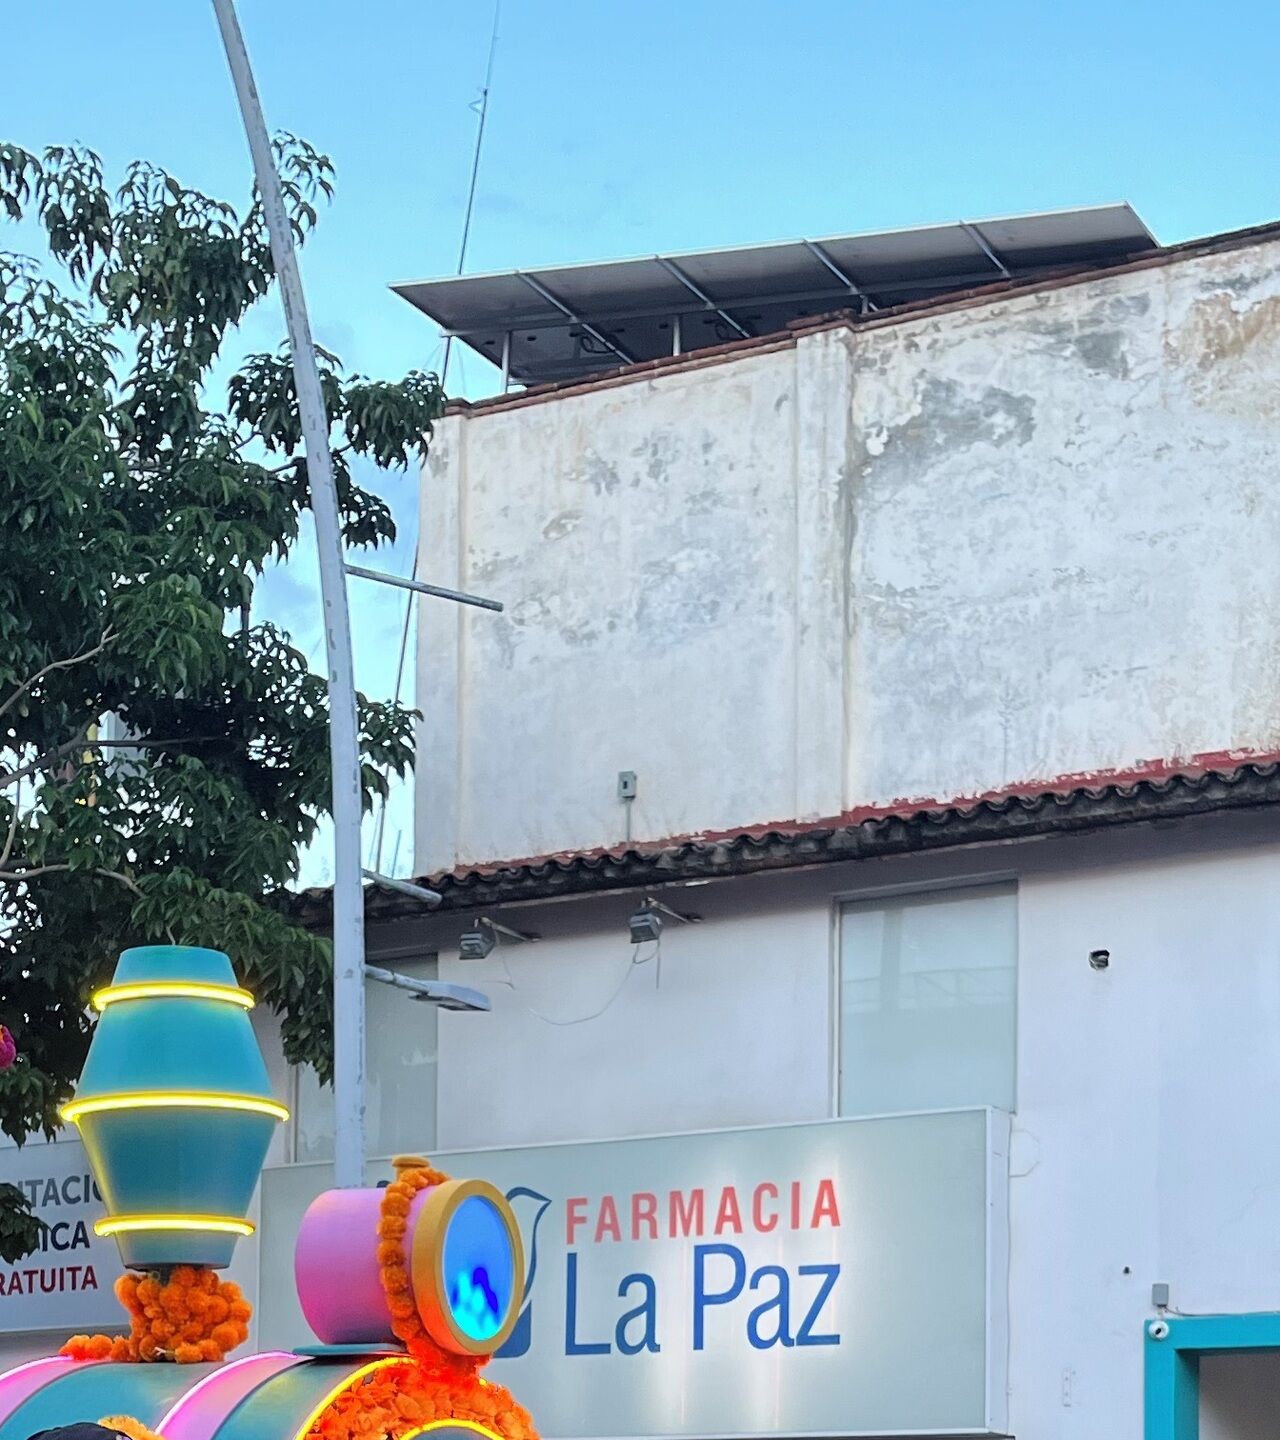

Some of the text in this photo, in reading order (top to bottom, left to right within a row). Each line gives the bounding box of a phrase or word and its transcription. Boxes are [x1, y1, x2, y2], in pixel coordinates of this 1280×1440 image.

[566, 1179, 841, 1245] FARMACIA
[565, 1243, 841, 1356] La Paz
